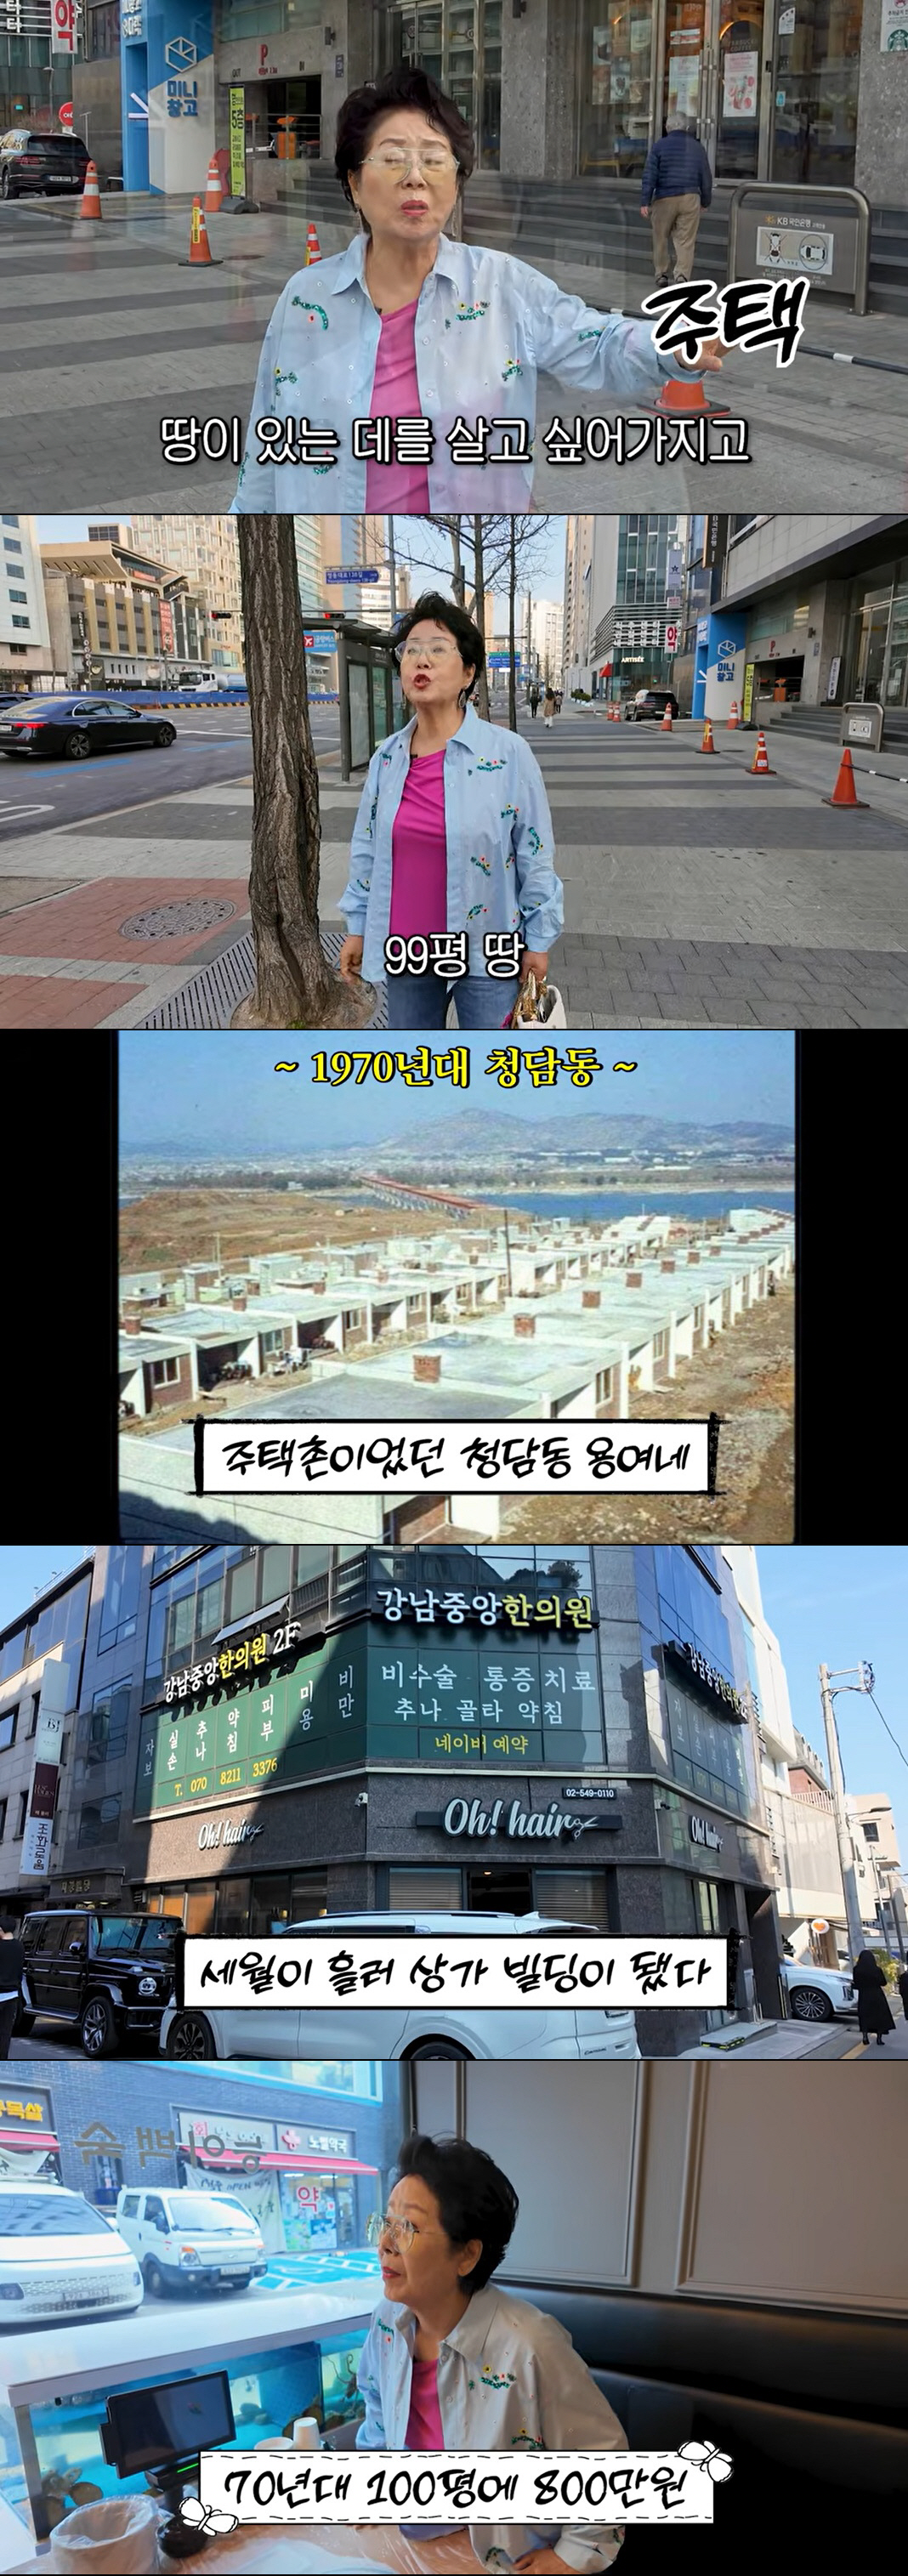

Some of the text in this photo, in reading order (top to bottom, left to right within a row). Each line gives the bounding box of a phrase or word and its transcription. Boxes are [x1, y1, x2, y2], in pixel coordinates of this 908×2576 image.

[54, 0, 75, 51] 약
[260, 44, 269, 65] P
[167, 80, 198, 99] 미니
[167, 98, 198, 118] 창고
[667, 626, 678, 652] 약
[717, 672, 735, 682] 창고
[718, 662, 735, 672] 미니
[377, 1587, 593, 1630] 강남중앙한의원
[163, 1620, 301, 1704] 강남중앙한의원 2F
[381, 1660, 596, 1694] 비수술 통증 치료
[299, 1680, 315, 1732] 미용
[338, 1664, 355, 1719] 비만
[260, 1694, 275, 1743] 피부
[393, 1698, 563, 1725] 추나 골타 약침
[195, 1719, 208, 1762] 추나
[226, 1710, 241, 1754] 약침
[434, 1733, 530, 1756] 네이버 예약
[143, 1739, 155, 1778] 자보
[167, 1729, 179, 1773] 실손
[174, 1756, 279, 1797] T. 070 8211 3376
[565, 1787, 616, 1799] 02-549-0110
[198, 1819, 251, 1849] Oh! hair
[445, 1798, 574, 1837] Oh! hair
[691, 1815, 705, 1845] Oh!
[298, 2187, 320, 2212] 약
